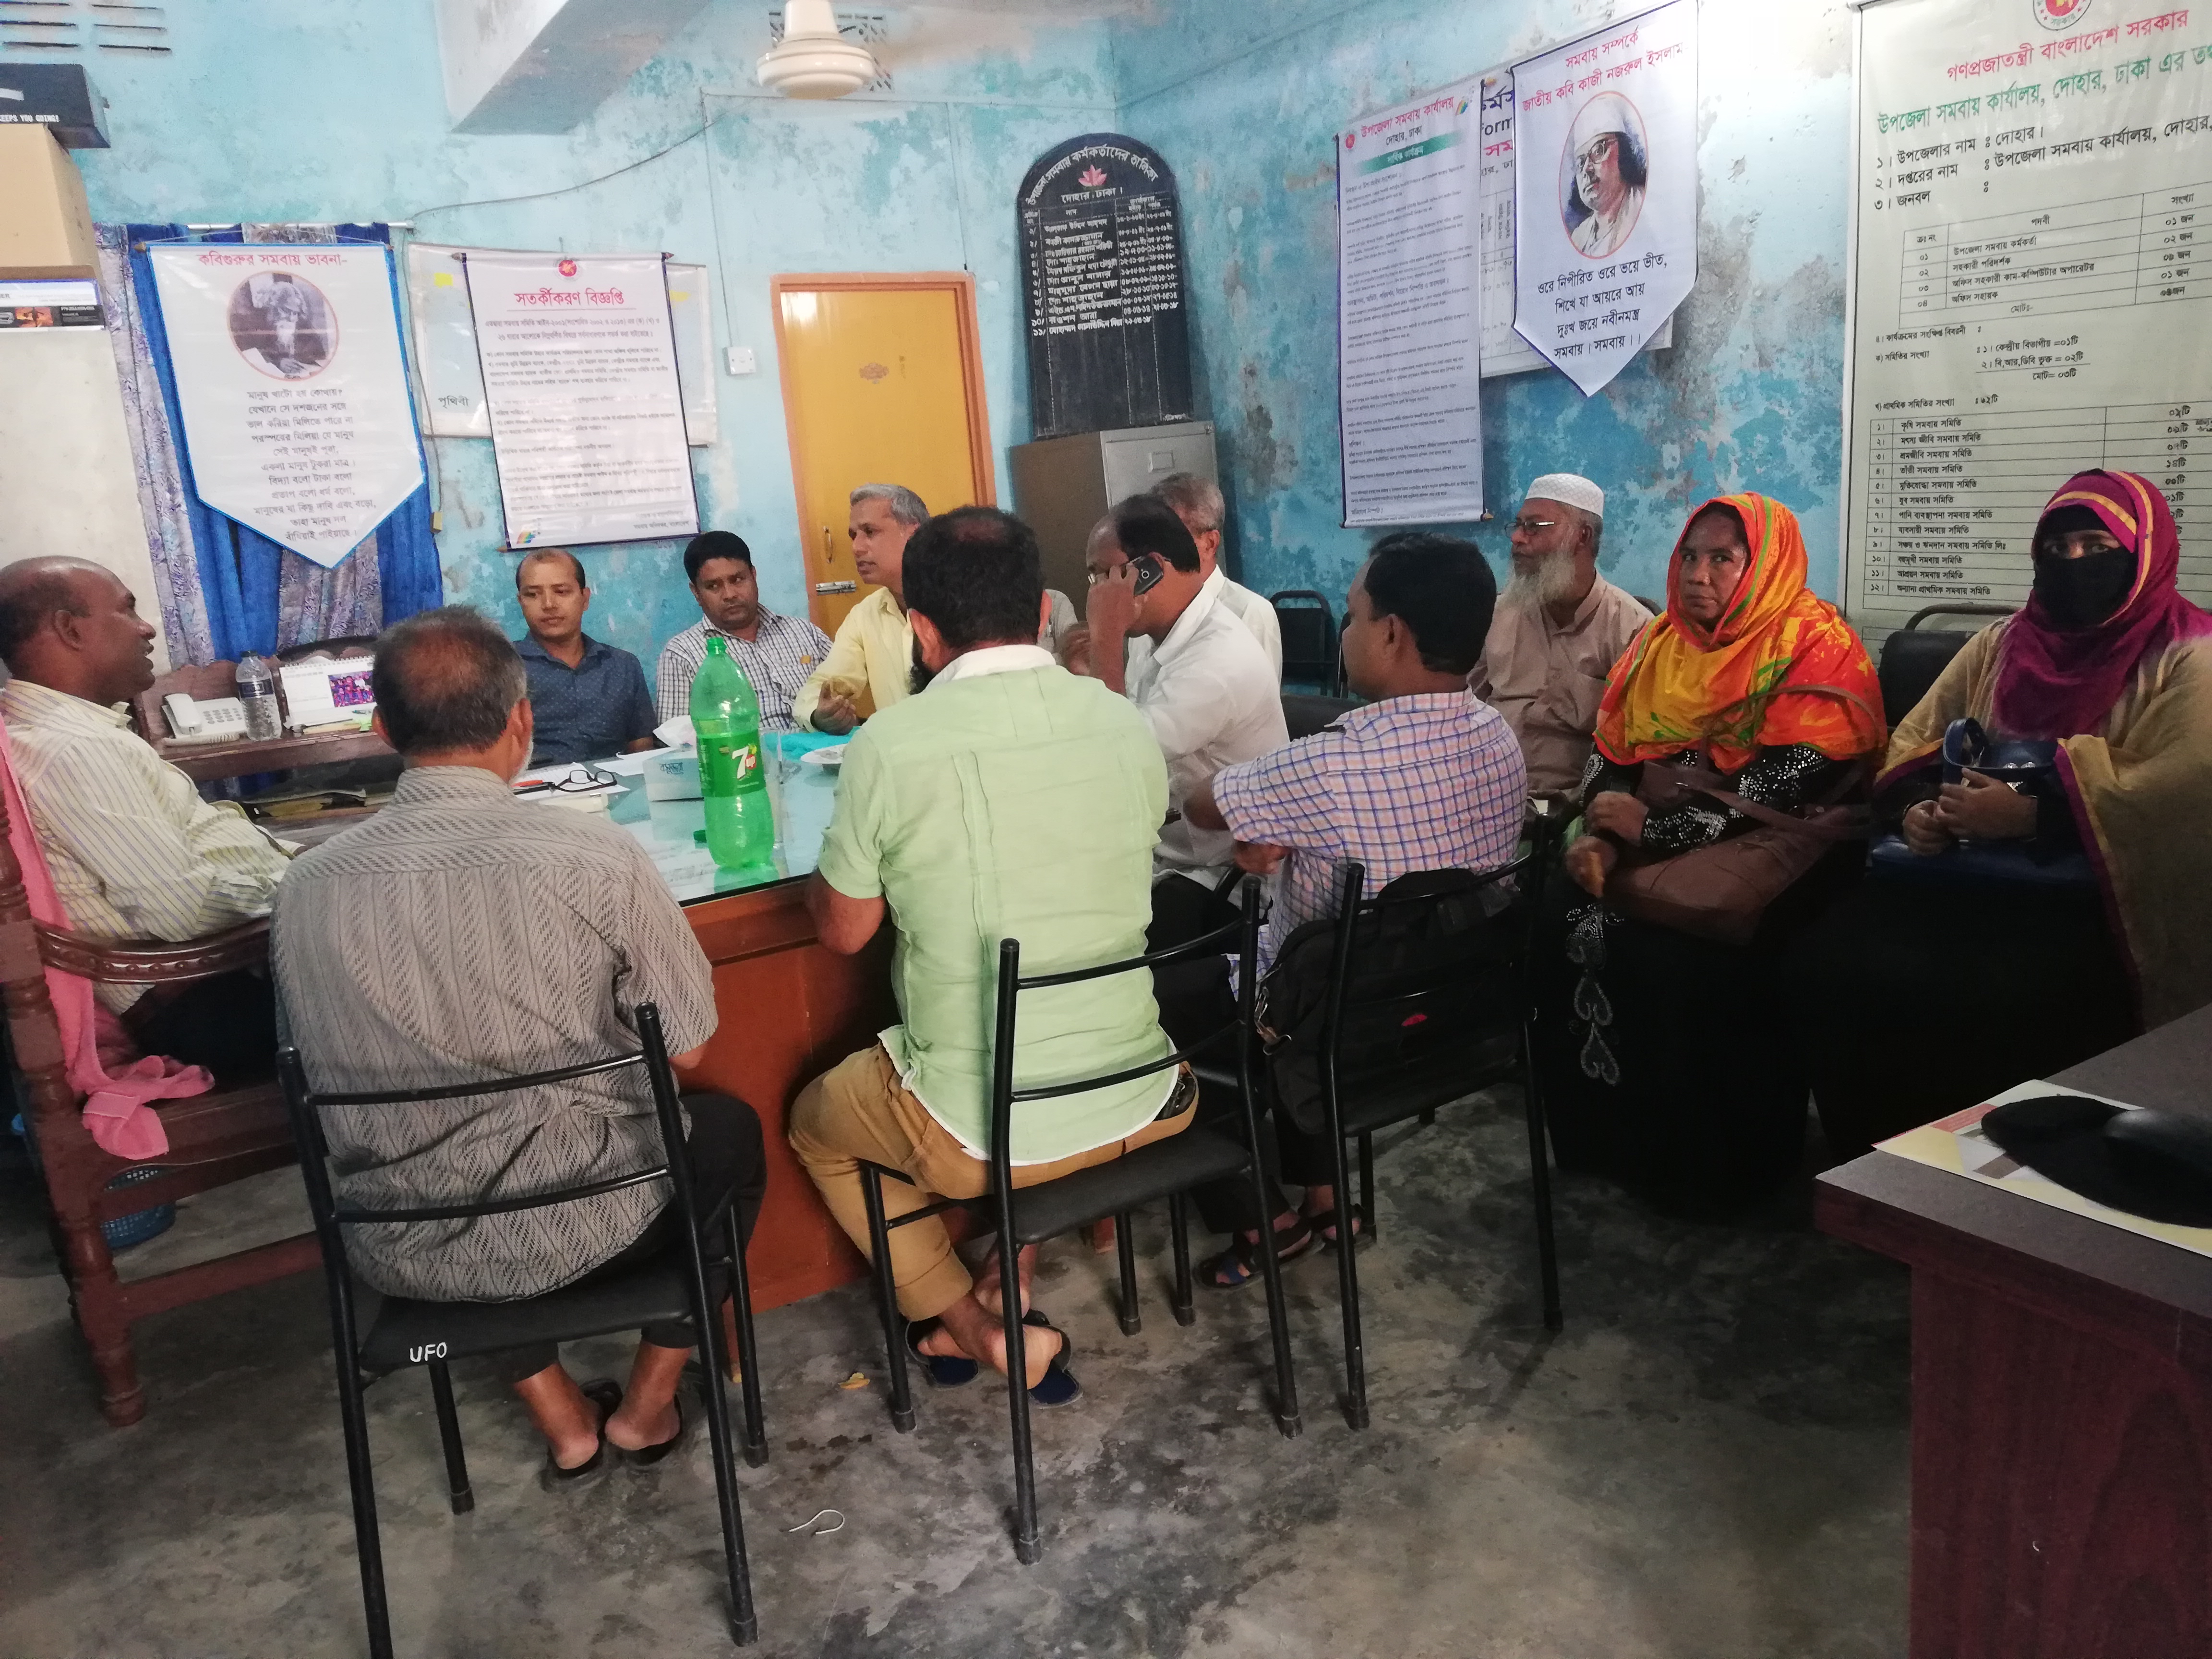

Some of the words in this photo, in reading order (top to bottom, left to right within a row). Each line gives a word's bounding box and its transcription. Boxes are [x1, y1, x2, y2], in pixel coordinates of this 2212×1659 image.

[1565, 47, 1599, 69] সমবায়
[1602, 25, 1639, 55] সম্পর্কে
[1948, 42, 2034, 81] গণপ্রজাতন্ত্রী
[2040, 24, 2119, 60] বাংলাদেশ
[2126, 9, 2189, 38] সরকার
[1522, 90, 1552, 112] জাতীয়
[1556, 80, 1574, 99] কবি
[1578, 69, 1602, 91] কাজী
[1606, 57, 1643, 79] নজরুল
[1877, 106, 1932, 133] উপজেলা
[1936, 97, 1981, 123] সমবায়
[1986, 80, 2045, 112] কার্যালয়,
[2053, 69, 2107, 99] দোহার,
[2114, 56, 2152, 84] ঢাকা
[2159, 50, 2187, 72] এর
[1361, 117, 1393, 137] উপজেলা
[1395, 108, 1421, 125] সমবায়
[1423, 96, 1454, 115] কার্যালয়
[1409, 126, 1422, 138] ঢাকা
[1897, 144, 1951, 164] উপজেলার
[1955, 138, 1977, 153] নাম
[1898, 168, 1934, 186] দপ্তরের
[1937, 164, 1959, 178] নাম
[1994, 145, 2046, 167] উপজেলা
[2051, 138, 2094, 157] সমবায়
[2098, 126, 2157, 148] কার্যালয়,
[1046, 156, 1072, 180] সমবায়
[1071, 144, 1131, 163] কর্মকর্তাদের
[1130, 154, 1159, 182] তালিকা
[1094, 187, 1116, 198] ঢাকা
[1896, 190, 1931, 206] জনবল
[1953, 245, 1983, 256] উপজেলা
[1985, 241, 2008, 252] সমবায়
[2010, 235, 2037, 248] কর্মকর্তা
[2165, 217, 2177, 226] ০১
[2181, 214, 2195, 224] জন
[197, 250, 254, 266] কবিগুরুর
[259, 253, 300, 265] সমবায়
[1953, 259, 1979, 272] সহকারী
[1981, 256, 2012, 268] পরিদর্শক
[2164, 235, 2176, 244] ০২
[2179, 232, 2193, 241] জন
[1538, 280, 1555, 293] ওরে
[1598, 265, 1616, 279] ওরে
[1620, 260, 1640, 273] ভয়ে
[1643, 252, 1667, 268] ভীত,
[1974, 273, 2001, 285] সহকারী
[2059, 263, 2094, 274] অপারেটর
[514, 287, 581, 306] সতর্কীকরণ
[585, 287, 624, 306] বিজ্ঞপ্তি
[1555, 297, 1575, 313] শিখে
[1579, 295, 1588, 307] যা
[1592, 288, 1622, 304] আয়রে
[1625, 283, 1646, 296] আয়
[1974, 291, 1998, 301] সহায়ক
[1557, 321, 1575, 339] দুঃখ
[1579, 316, 1599, 331] জয়ে
[1885, 351, 1908, 361] সমিতির
[1910, 350, 1930, 359] সংখ্যা
[1996, 340, 2020, 352] কেন্দ্রীয়
[2022, 337, 2051, 349] বিভাগীয়
[247, 391, 269, 400] মানুষ
[437, 395, 469, 409] পৃথিবী
[248, 405, 276, 414] যেখানে
[280, 405, 290, 413] সে
[292, 403, 328, 412] দশজনের
[1908, 398, 1933, 409] সমিতির
[1936, 397, 1955, 407] সংখ্যা
[246, 420, 263, 429] ভাল
[266, 418, 290, 428] করিয়া
[293, 416, 321, 426] মিলিতে
[345, 416, 354, 424] না
[1916, 420, 1938, 429] সমবায়
[1941, 417, 1962, 427] সমিতি
[294, 431, 319, 441] মিলিয়া
[323, 431, 332, 440] যে
[335, 430, 354, 440] মানুষ
[1937, 435, 1960, 443] সমবায়
[1962, 432, 1982, 442] সমিতি
[273, 447, 289, 456] সেই
[1927, 450, 1950, 459] সমবায়
[1952, 448, 1972, 457] সমিতি
[261, 462, 285, 471] একলা
[288, 461, 308, 471] মানুষ
[1917, 466, 1939, 474] সমবায়
[1942, 463, 1963, 473] সমিতি
[269, 475, 290, 485] বিদ্যা
[293, 474, 311, 484] বলো
[313, 472, 332, 482] টাকা
[334, 472, 352, 481] বলো
[1932, 481, 1954, 489] সমবায়
[1956, 479, 1977, 488] সমিতি
[271, 489, 295, 499] প্রতাপ
[298, 488, 316, 498] বলো
[319, 486, 331, 496] ধর্ম
[1910, 496, 1931, 505] সমবায়
[1933, 494, 1954, 504] সমিতি
[253, 506, 284, 517] মানুষের
[287, 505, 296, 514] যা
[297, 502, 314, 513] কিছু
[336, 500, 353, 509] এবং
[1899, 510, 1911, 519] পানি
[1948, 511, 1970, 519] সমবায়
[1972, 509, 1993, 519] সমিতি
[290, 517, 308, 527] তাহা
[311, 516, 331, 526] মানুষ
[1923, 526, 1946, 534] সমবায়
[1948, 525, 1969, 534] সমিতি
[1947, 541, 1970, 550] সমবায়
[1972, 540, 1993, 549] সমিতি
[1919, 556, 1939, 565] সমবায়
[1942, 555, 1962, 565] সমিতি
[1920, 571, 1940, 579] সমবায়
[1943, 570, 1963, 579] সমিতি
[1946, 587, 1967, 595] সমবায়
[1970, 585, 1991, 595] সমিতি
[409, 1342, 447, 1362] UFO
